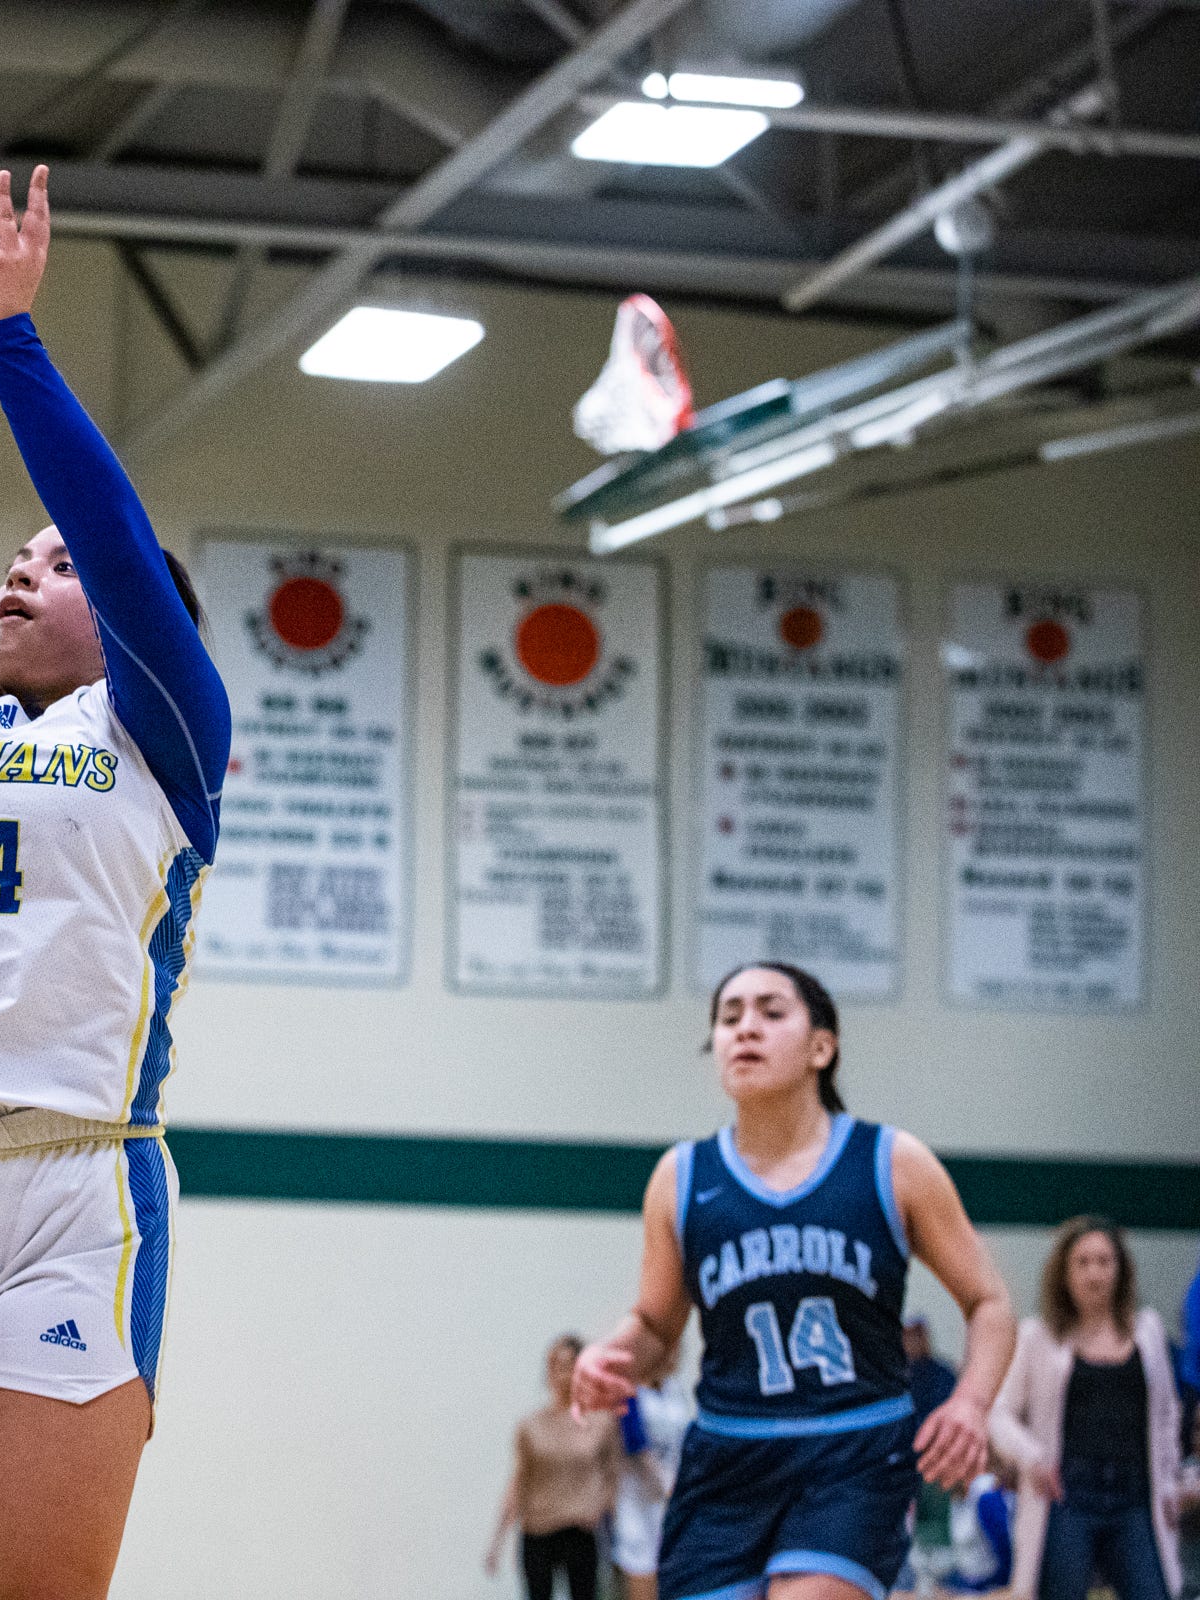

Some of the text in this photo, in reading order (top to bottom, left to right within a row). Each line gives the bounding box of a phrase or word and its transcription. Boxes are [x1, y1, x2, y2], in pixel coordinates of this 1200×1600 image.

[699, 1223, 879, 1311] CARROLL
[40, 1333, 87, 1351] adidas
[744, 1296, 857, 1396] 14
